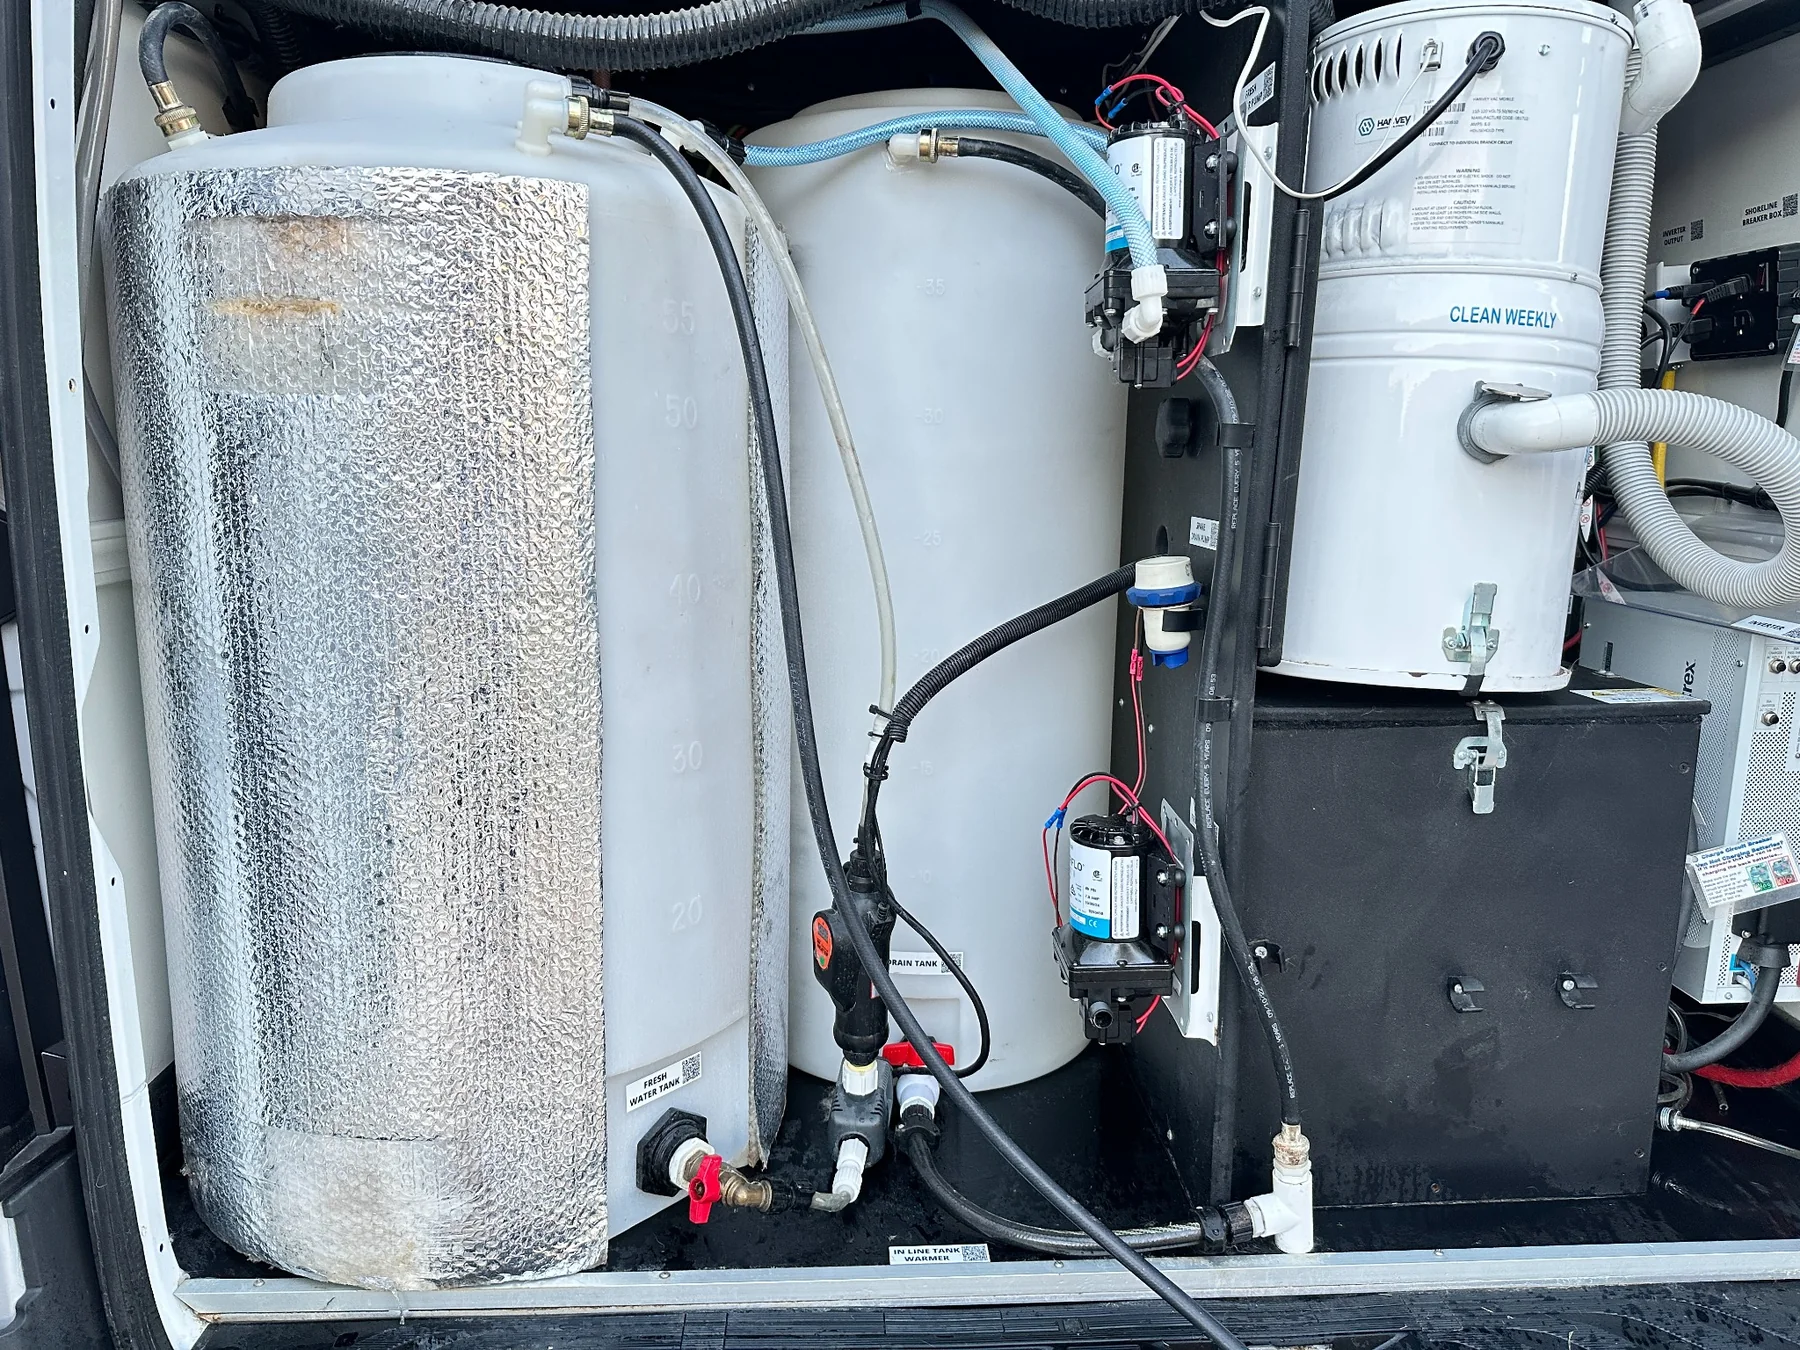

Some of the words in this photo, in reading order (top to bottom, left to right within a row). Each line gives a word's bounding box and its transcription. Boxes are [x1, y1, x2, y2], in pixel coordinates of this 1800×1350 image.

[1742, 213, 1768, 226] BREAKER
[1769, 210, 1782, 220] BOX
[1745, 201, 1778, 216] SHORELINE
[1662, 226, 1686, 237] INVERTER
[1664, 236, 1684, 245] OUTPUT
[662, 298, 696, 335] 55
[1450, 306, 1501, 324] CLEAN
[1505, 308, 1556, 328] WEEKLY
[665, 393, 698, 430] 50
[1231, 498, 1239, 529] REPLACE
[669, 573, 702, 606] 40
[1748, 620, 1784, 630] INVERTER
[672, 740, 704, 774] 30
[1204, 801, 1212, 828] REPLACE
[1702, 850, 1724, 860] Charge
[1725, 845, 1746, 853] Circuit
[1747, 837, 1772, 846] Breaker
[1722, 850, 1750, 860] Charging
[1702, 868, 1727, 876] charging
[671, 895, 702, 932] 20
[1271, 1022, 1282, 1042] YEARS
[630, 1088, 657, 1106] WATER
[659, 1076, 680, 1093] TANK
[644, 1072, 667, 1089] FRESH
[1286, 1072, 1296, 1098] REPLACE
